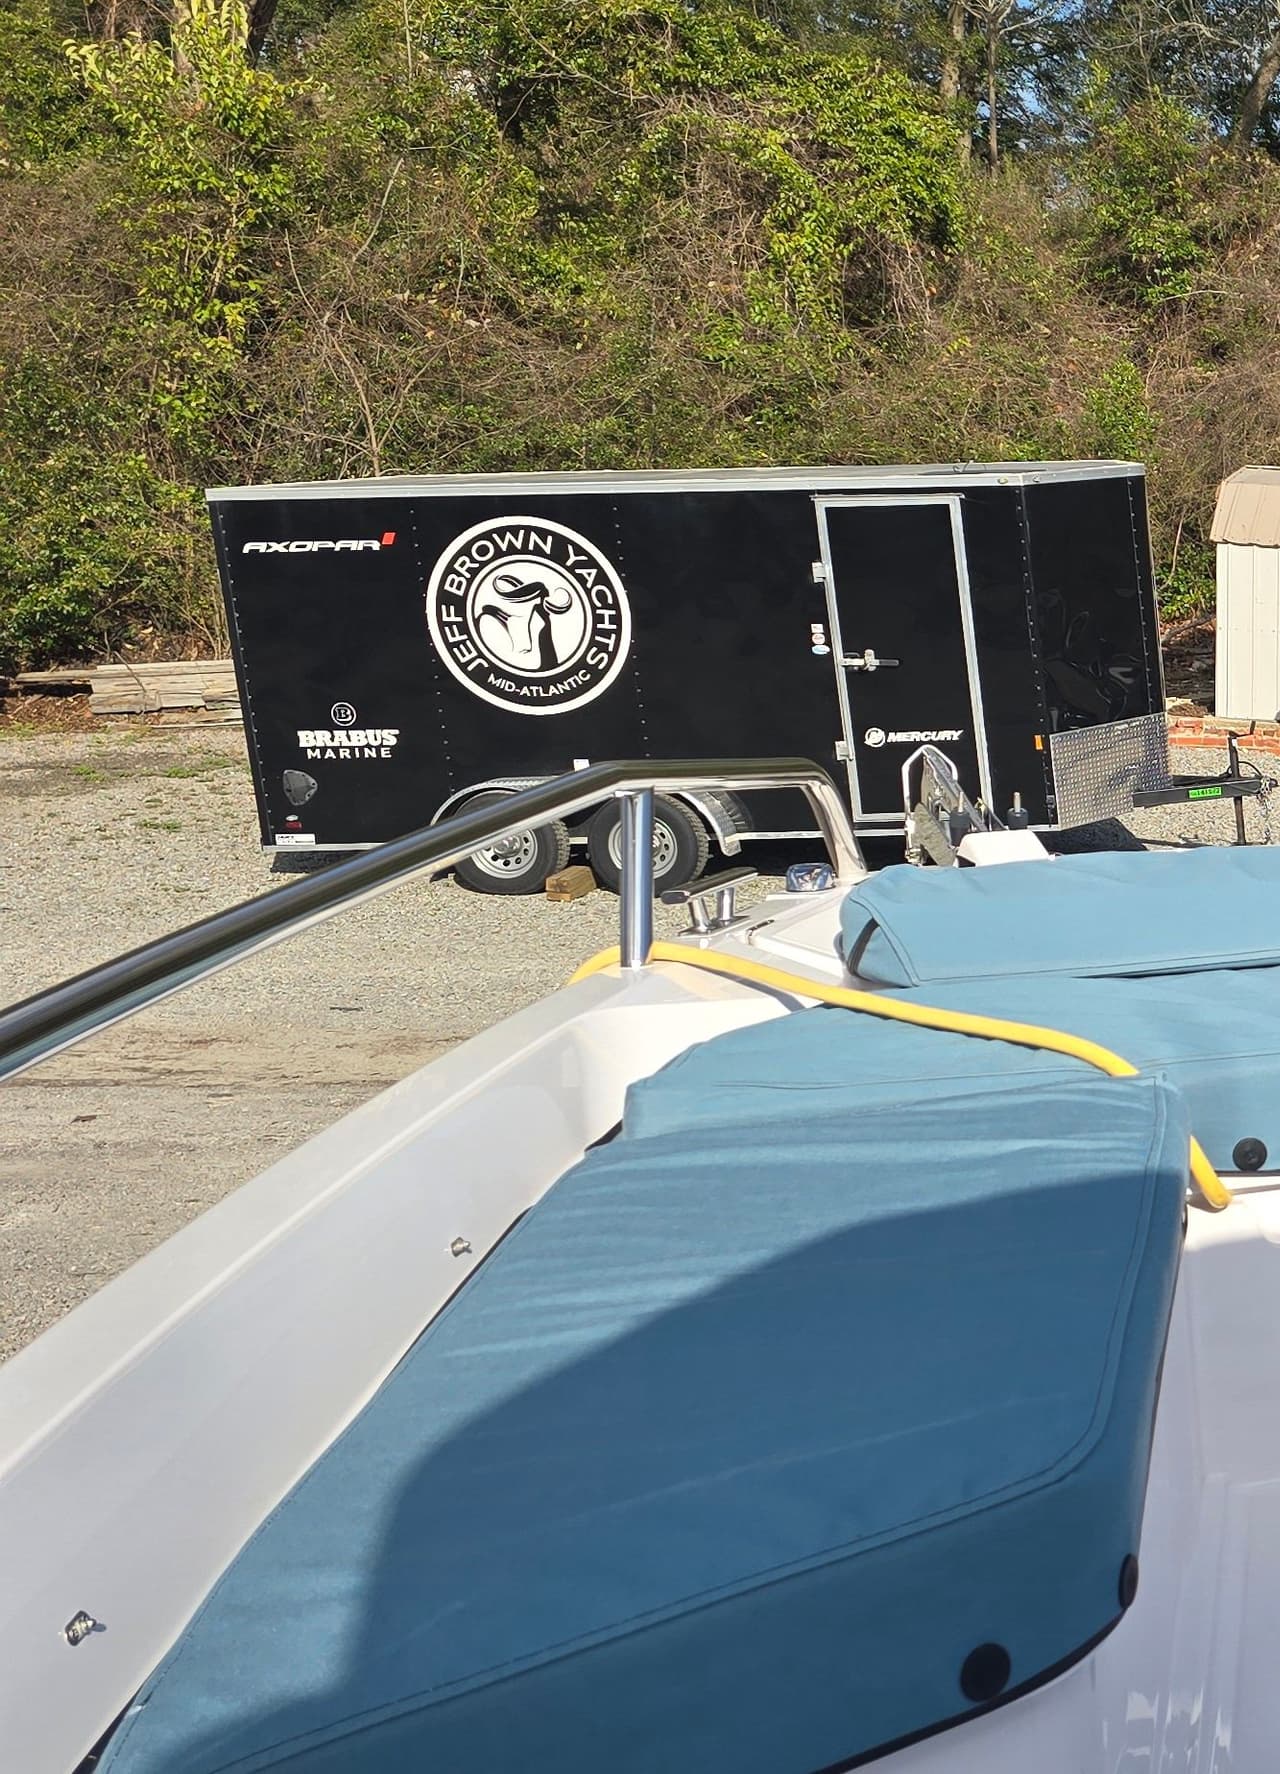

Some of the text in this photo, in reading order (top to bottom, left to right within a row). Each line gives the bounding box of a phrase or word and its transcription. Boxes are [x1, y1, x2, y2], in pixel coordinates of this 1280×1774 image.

[242, 540, 381, 554] AXOPAR
[441, 529, 617, 672] JEFF BROWN YACHTS
[487, 669, 591, 697] MID-ATLANTIC
[297, 729, 400, 748] BRABUS
[887, 730, 964, 743] MERCURY
[307, 747, 392, 759] MARINE
